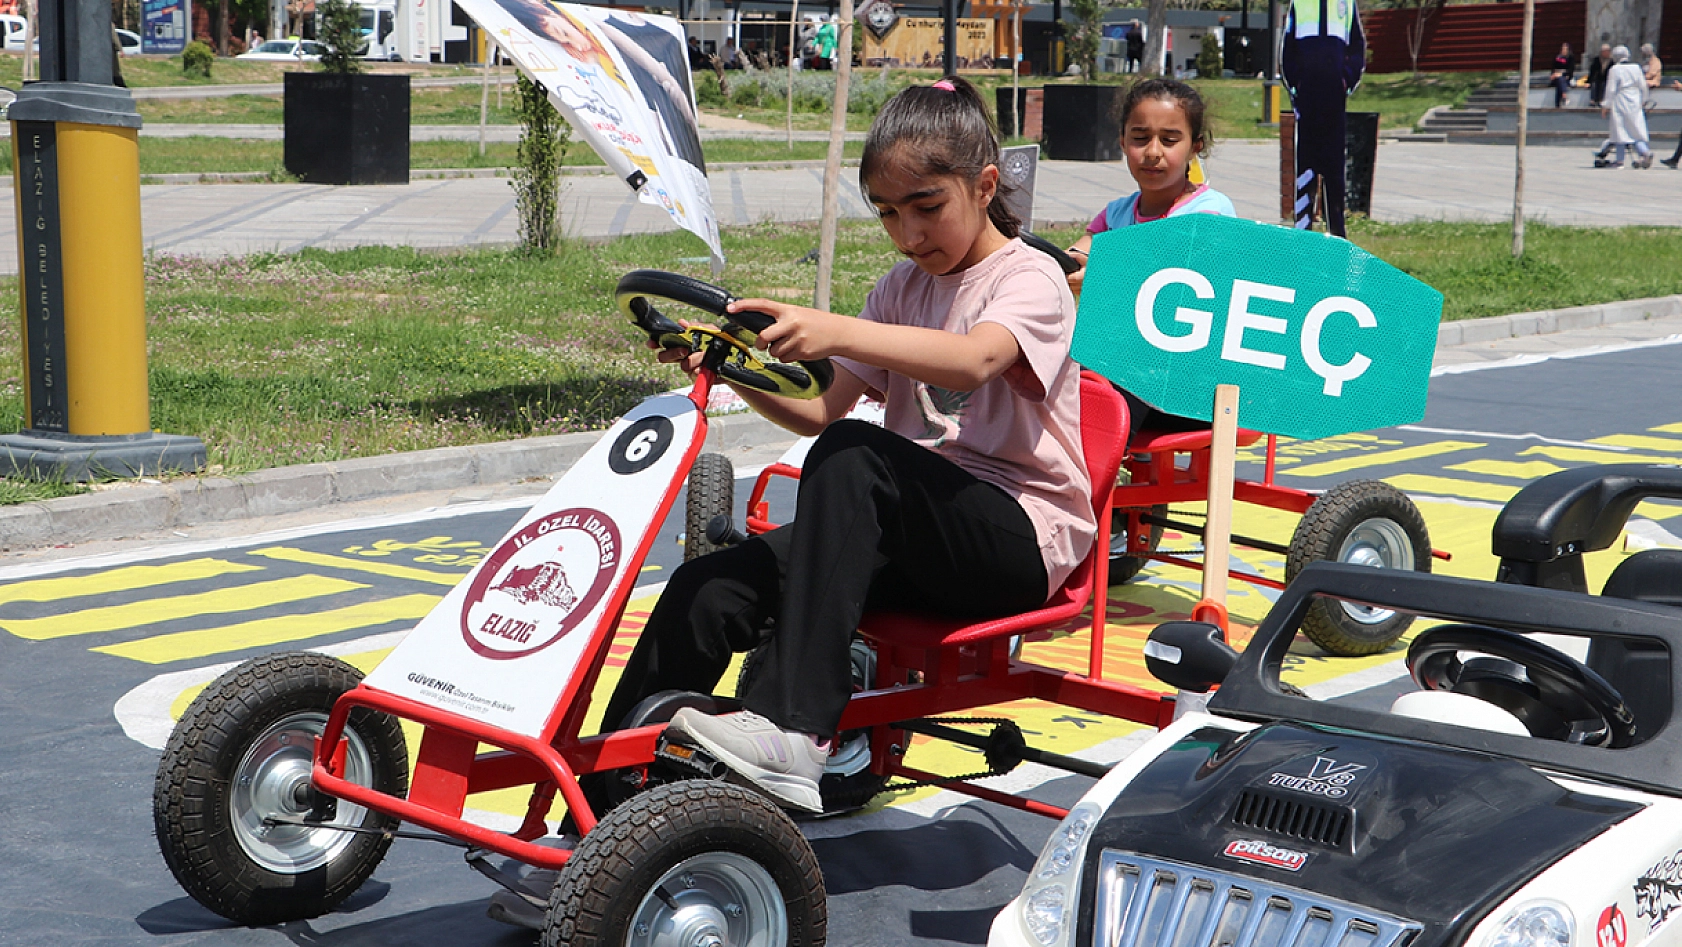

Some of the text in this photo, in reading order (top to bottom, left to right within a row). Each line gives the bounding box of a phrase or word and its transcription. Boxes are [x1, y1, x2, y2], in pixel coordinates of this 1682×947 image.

[1134, 267, 1378, 397] GEÇ
[625, 428, 659, 461] 6
[537, 514, 580, 535] ÖZEL
[479, 612, 540, 644] ELAZIĞ
[407, 671, 456, 694] GÜVENİR
[1268, 772, 1349, 798] TURBO
[1230, 840, 1309, 865] pitsan
